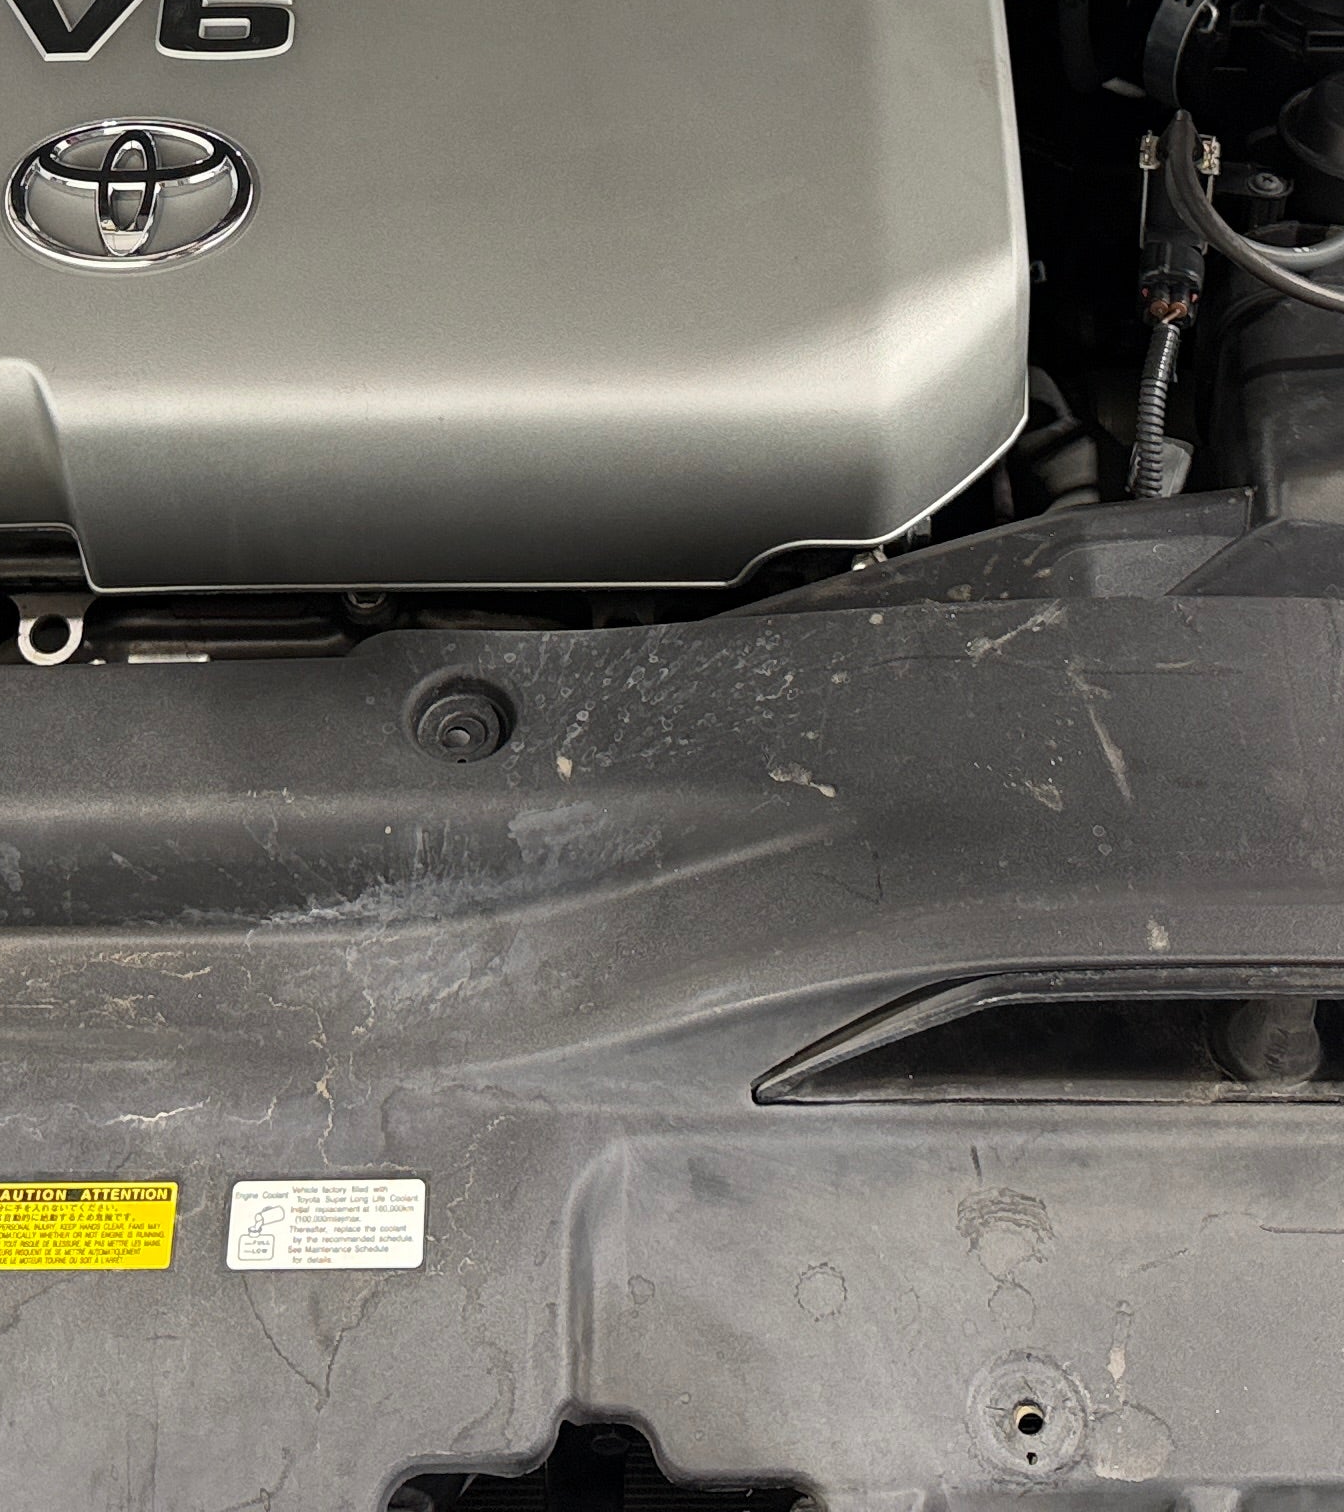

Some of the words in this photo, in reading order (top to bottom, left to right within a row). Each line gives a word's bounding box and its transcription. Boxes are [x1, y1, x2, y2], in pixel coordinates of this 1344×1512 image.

[80, 1188, 168, 1201] ATTENTION
[236, 1192, 258, 1201] Engine
[262, 1191, 289, 1200] Coolant
